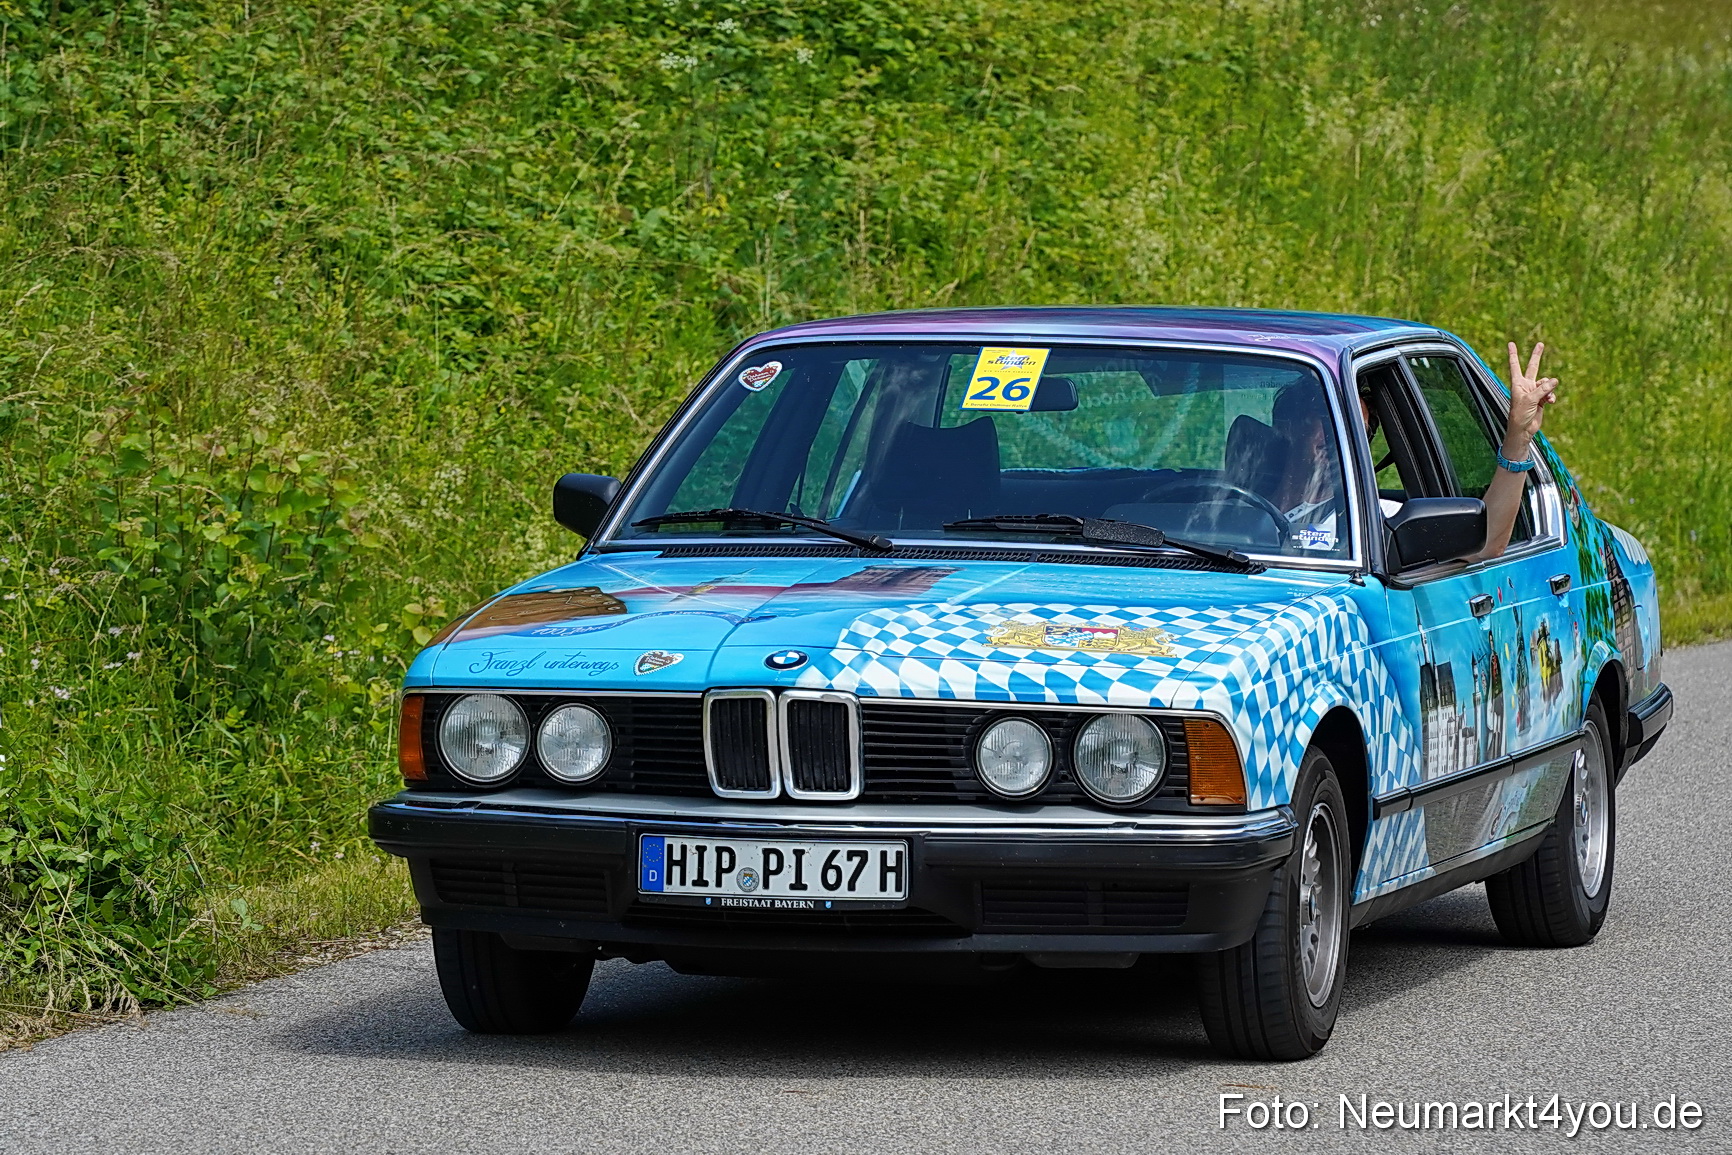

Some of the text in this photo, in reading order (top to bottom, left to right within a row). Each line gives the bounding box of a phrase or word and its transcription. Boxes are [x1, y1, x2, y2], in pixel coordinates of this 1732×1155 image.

[969, 376, 1031, 402] 26
[544, 651, 619, 677] unterwegs
[648, 869, 658, 882] D
[666, 843, 737, 888] HIP
[761, 847, 808, 891] PI
[720, 897, 815, 909] FREISTAAT BAYERN
